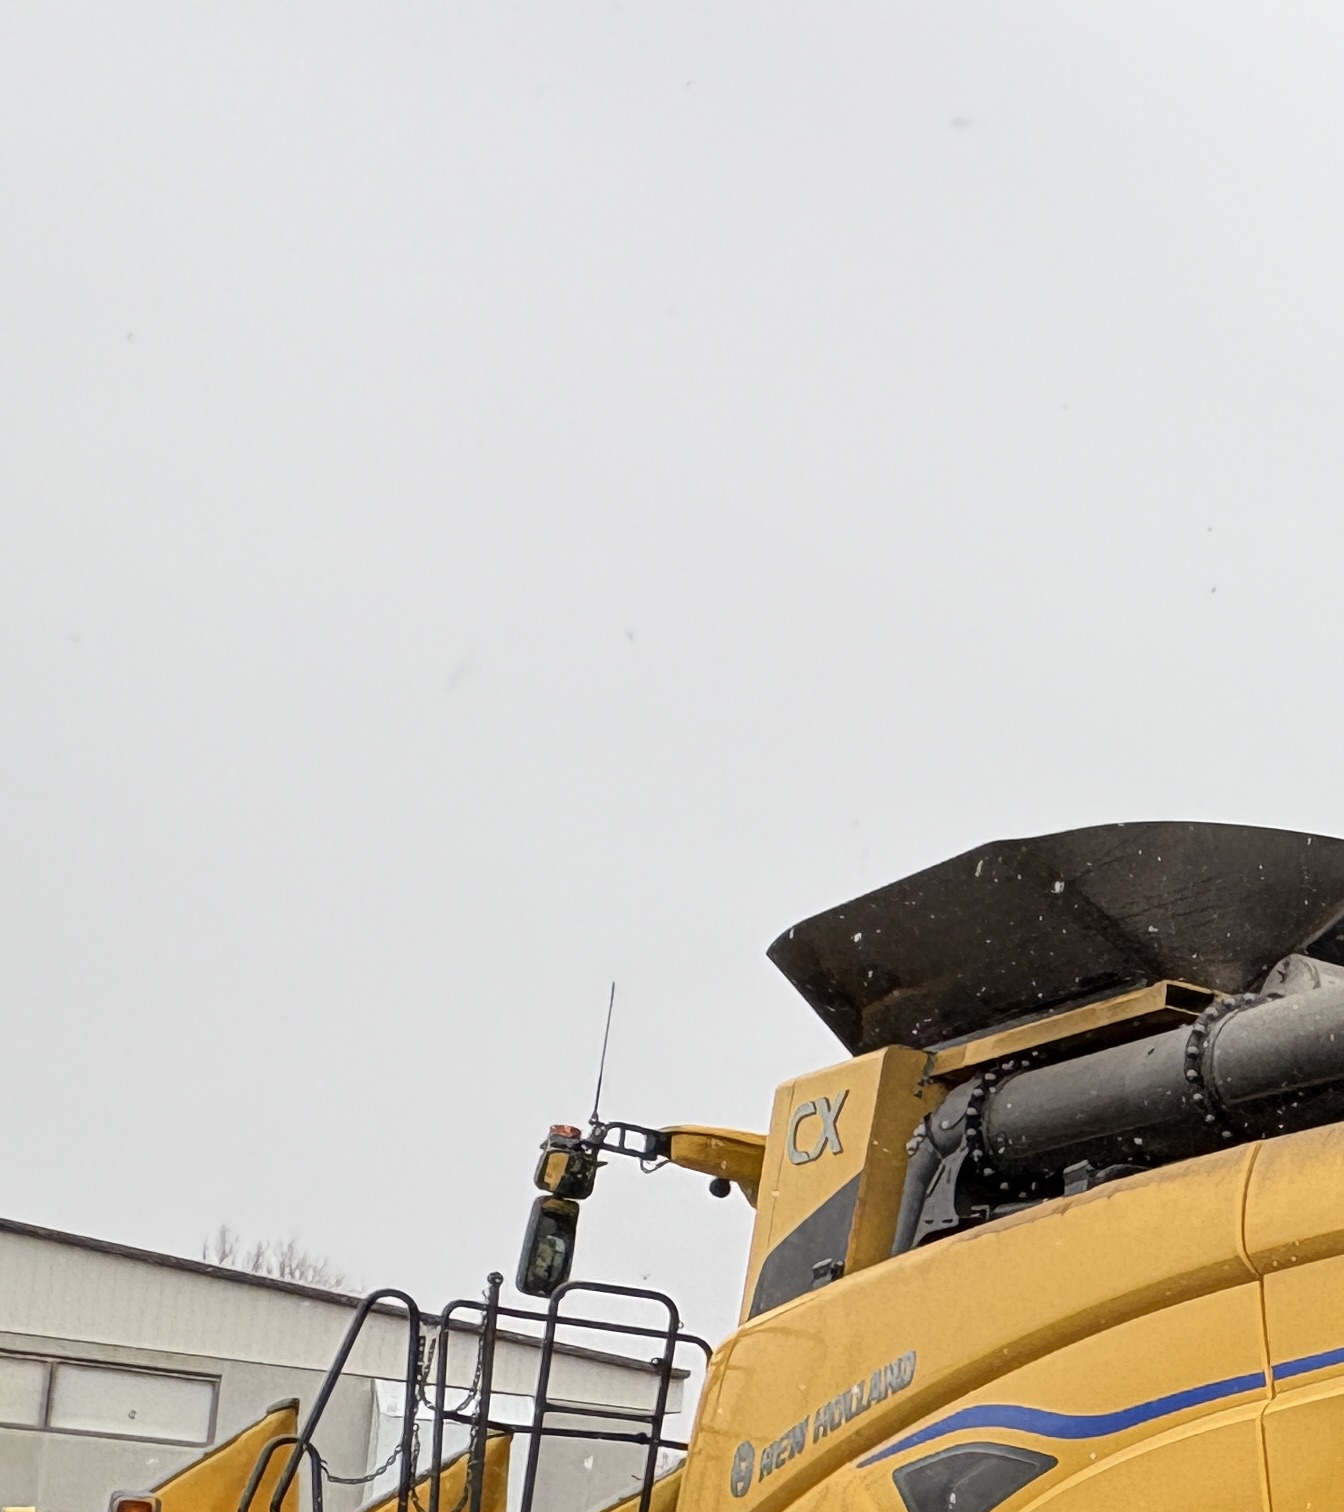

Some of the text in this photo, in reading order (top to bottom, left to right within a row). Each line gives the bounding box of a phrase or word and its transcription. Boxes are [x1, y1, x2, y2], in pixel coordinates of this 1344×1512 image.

[786, 1088, 850, 1165] CX
[758, 1350, 917, 1483] NEW HOLLAND
